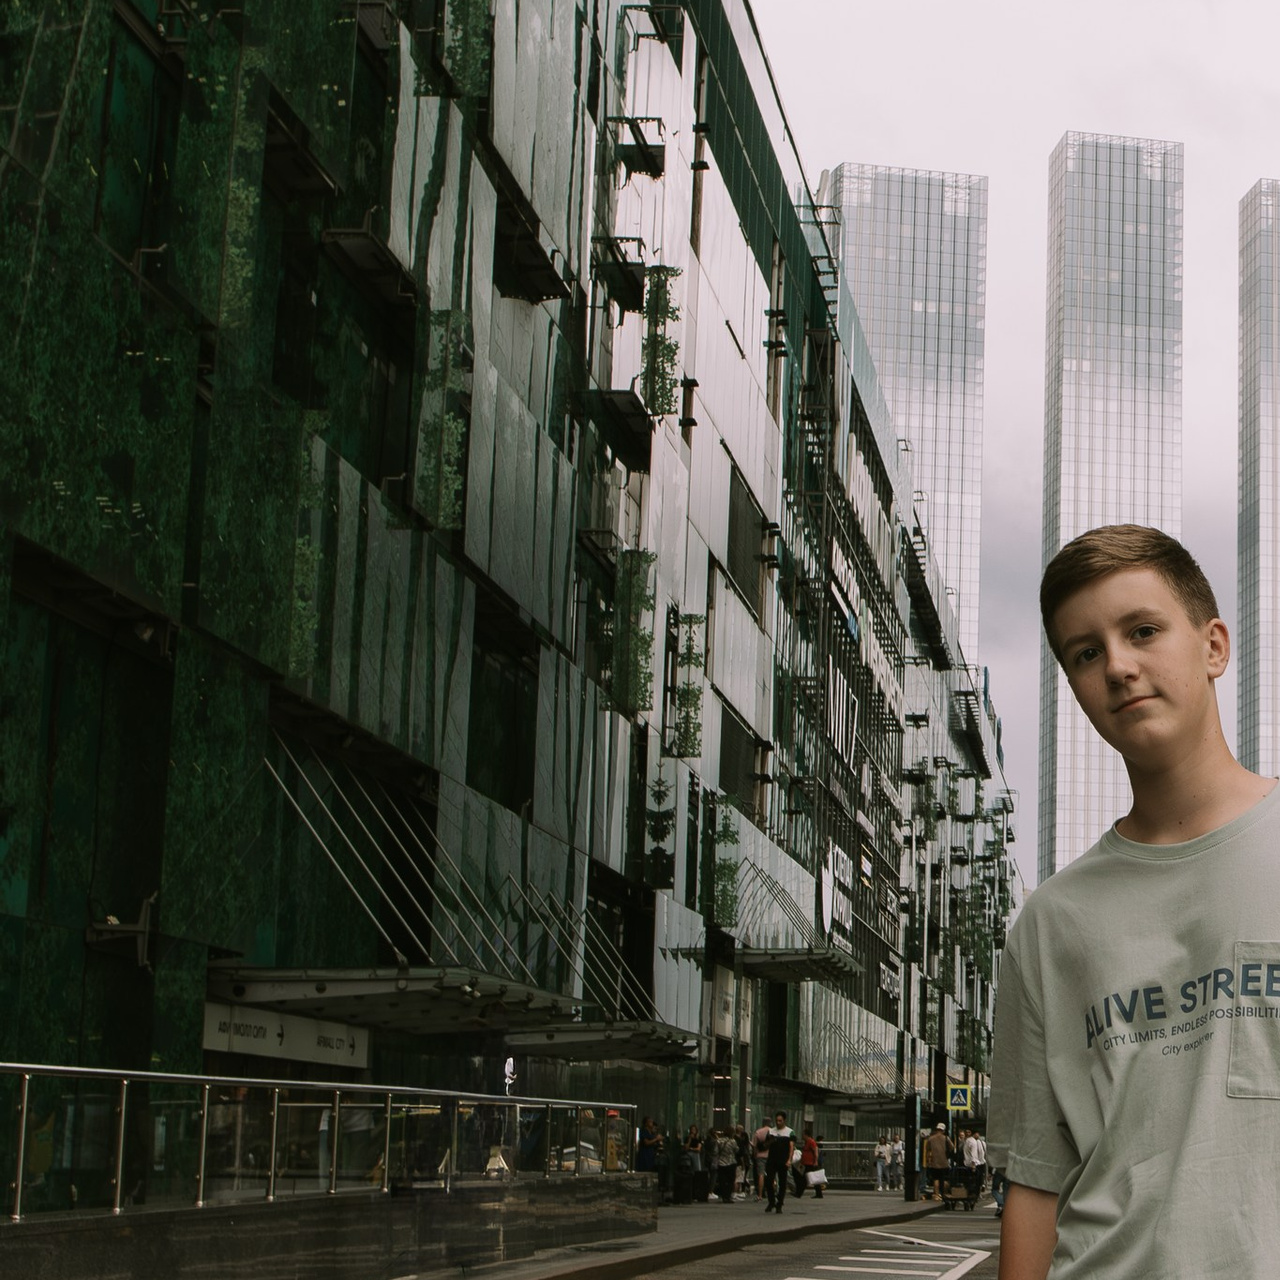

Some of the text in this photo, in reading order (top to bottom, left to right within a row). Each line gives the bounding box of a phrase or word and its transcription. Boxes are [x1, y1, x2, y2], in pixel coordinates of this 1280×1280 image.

[1085, 985, 1167, 1050] ALIVE
[1103, 1034, 1126, 1051] CITY
[1129, 1028, 1168, 1044] LIMITS,
[1171, 1012, 1208, 1036] ENDLESS
[1161, 1043, 1182, 1056] City
